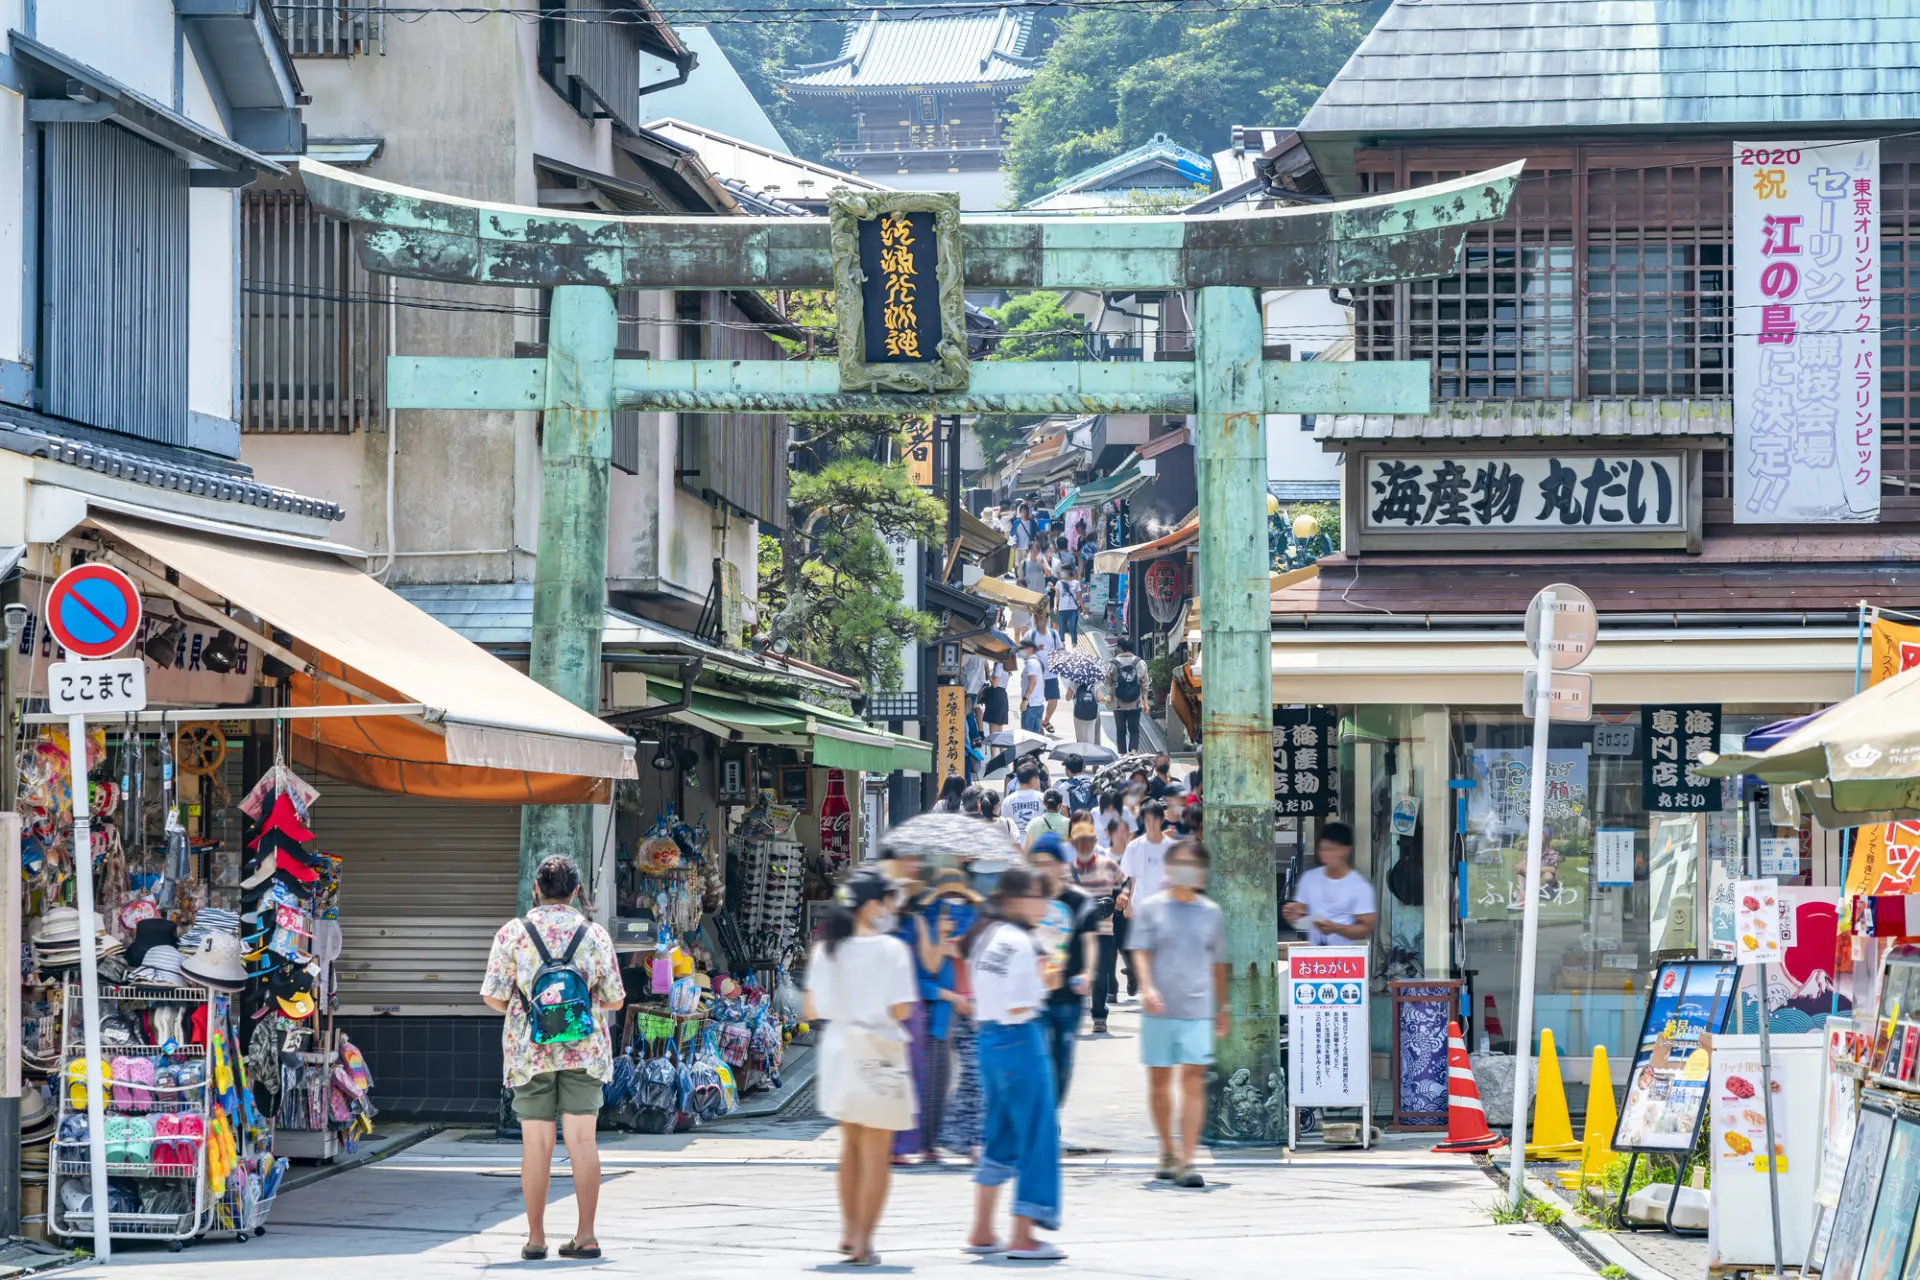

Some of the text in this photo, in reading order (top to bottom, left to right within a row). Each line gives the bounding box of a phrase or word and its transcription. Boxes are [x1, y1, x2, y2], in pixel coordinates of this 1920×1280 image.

[1741, 149, 1801, 165] 2020
[1753, 168, 1788, 200] 祝
[1793, 166, 1851, 469] セーリング競技会場
[1852, 178, 1873, 486] 東京オリンピック・パラリンピック
[1371, 457, 1672, 526] 海産物 丸だい
[60, 673, 133, 702] ここまで
[1292, 724, 1319, 794] 海産物
[1651, 709, 1679, 787] 専門店
[1658, 792, 1706, 808] 丸だい
[1299, 960, 1357, 975] おねがい
